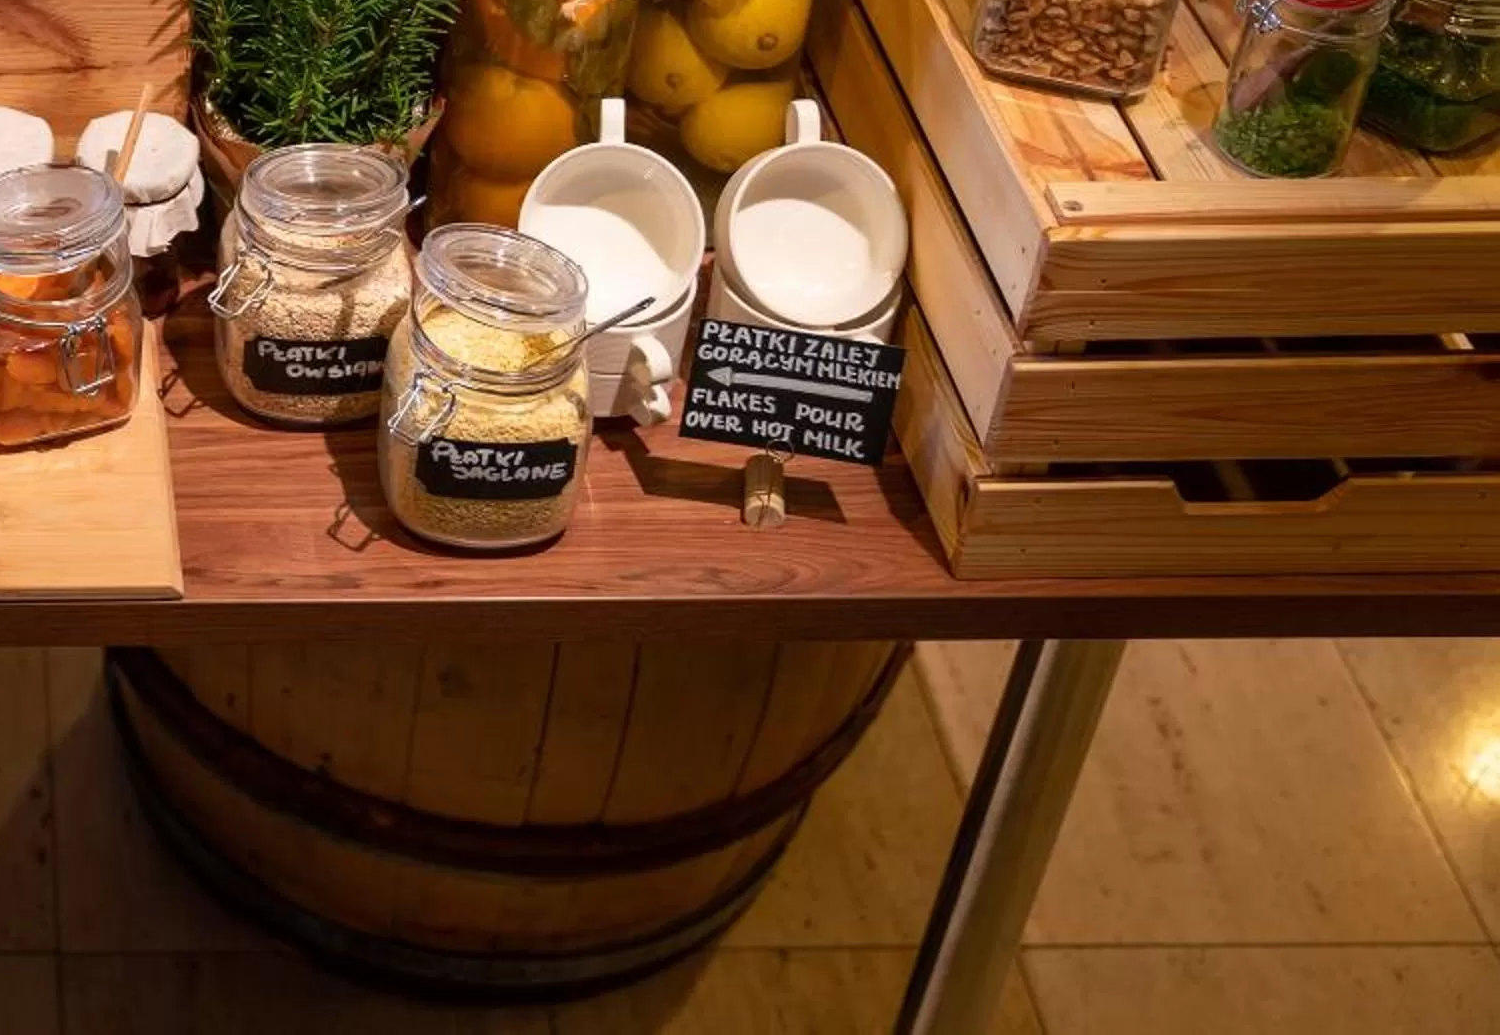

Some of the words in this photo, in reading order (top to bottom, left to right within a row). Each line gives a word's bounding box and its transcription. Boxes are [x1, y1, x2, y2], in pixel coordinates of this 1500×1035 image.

[698, 343, 813, 377] GORĄCYM
[818, 364, 901, 390] MLEKIEM
[702, 321, 797, 354] PŁATKI
[803, 339, 881, 367] ZALEJ
[691, 388, 777, 415] FLAKES
[795, 402, 865, 432] POUR
[685, 411, 743, 433] OVER
[752, 419, 795, 442] HOT
[803, 429, 865, 459] MILK
